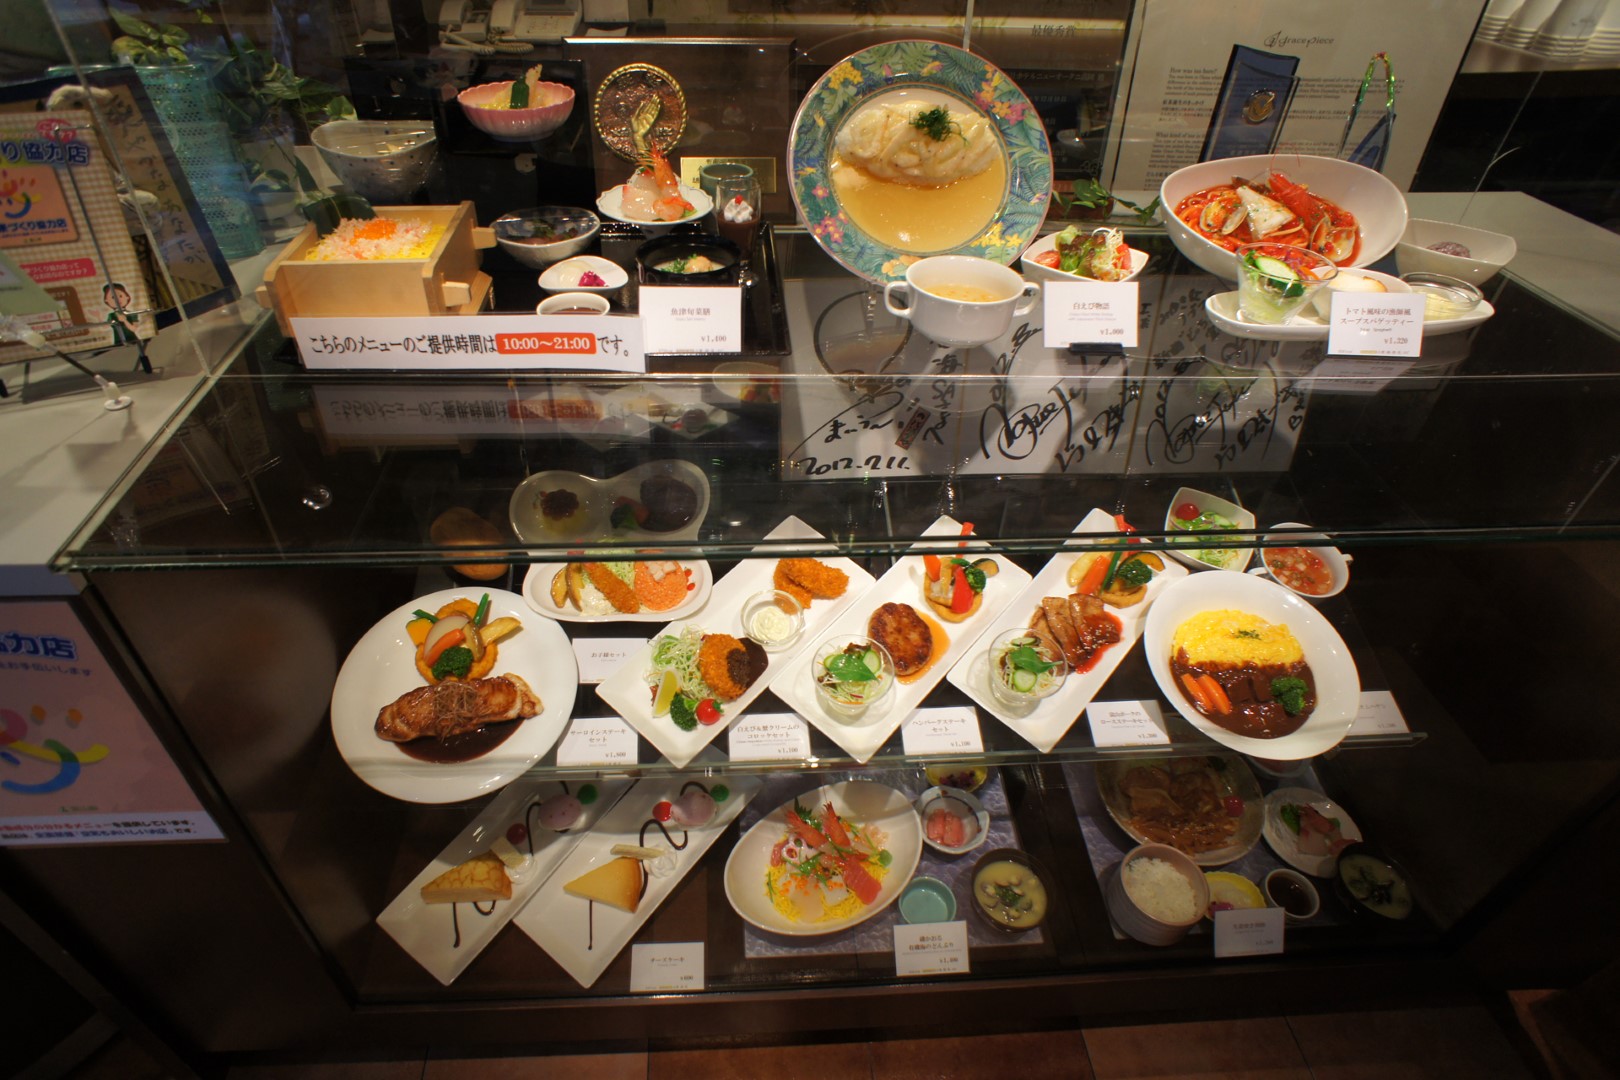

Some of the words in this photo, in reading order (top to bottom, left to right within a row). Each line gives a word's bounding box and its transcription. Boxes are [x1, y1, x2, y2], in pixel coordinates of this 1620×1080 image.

[309, 334, 496, 355] こちらのメニューのご提供時間は
